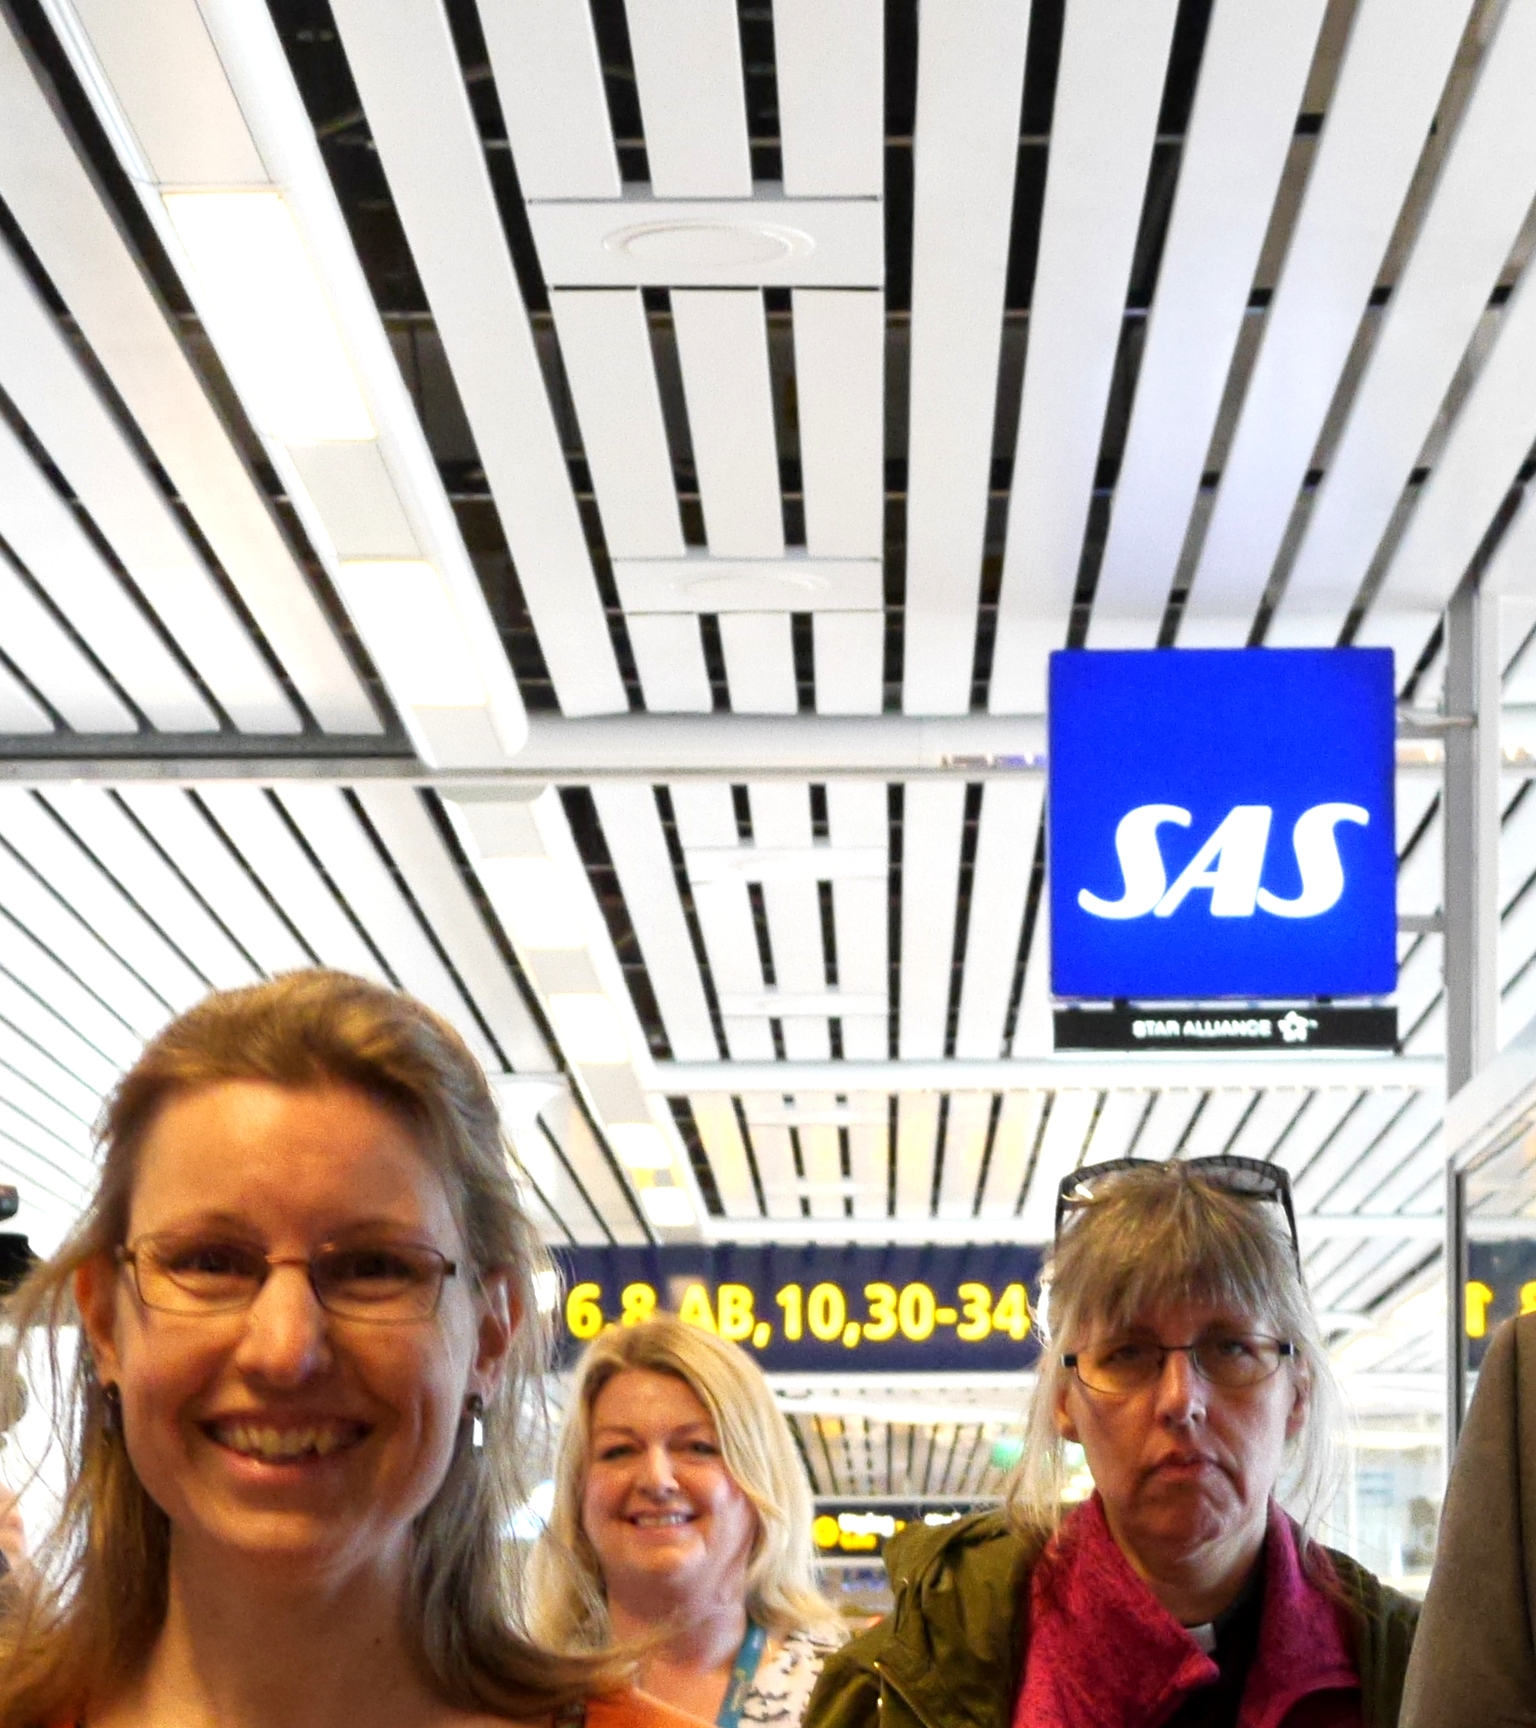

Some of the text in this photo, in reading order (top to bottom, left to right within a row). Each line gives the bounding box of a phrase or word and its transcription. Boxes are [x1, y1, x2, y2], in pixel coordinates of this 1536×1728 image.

[1077, 802, 1370, 919] SAS
[1132, 1018, 1272, 1038] STAR ALLIANCE
